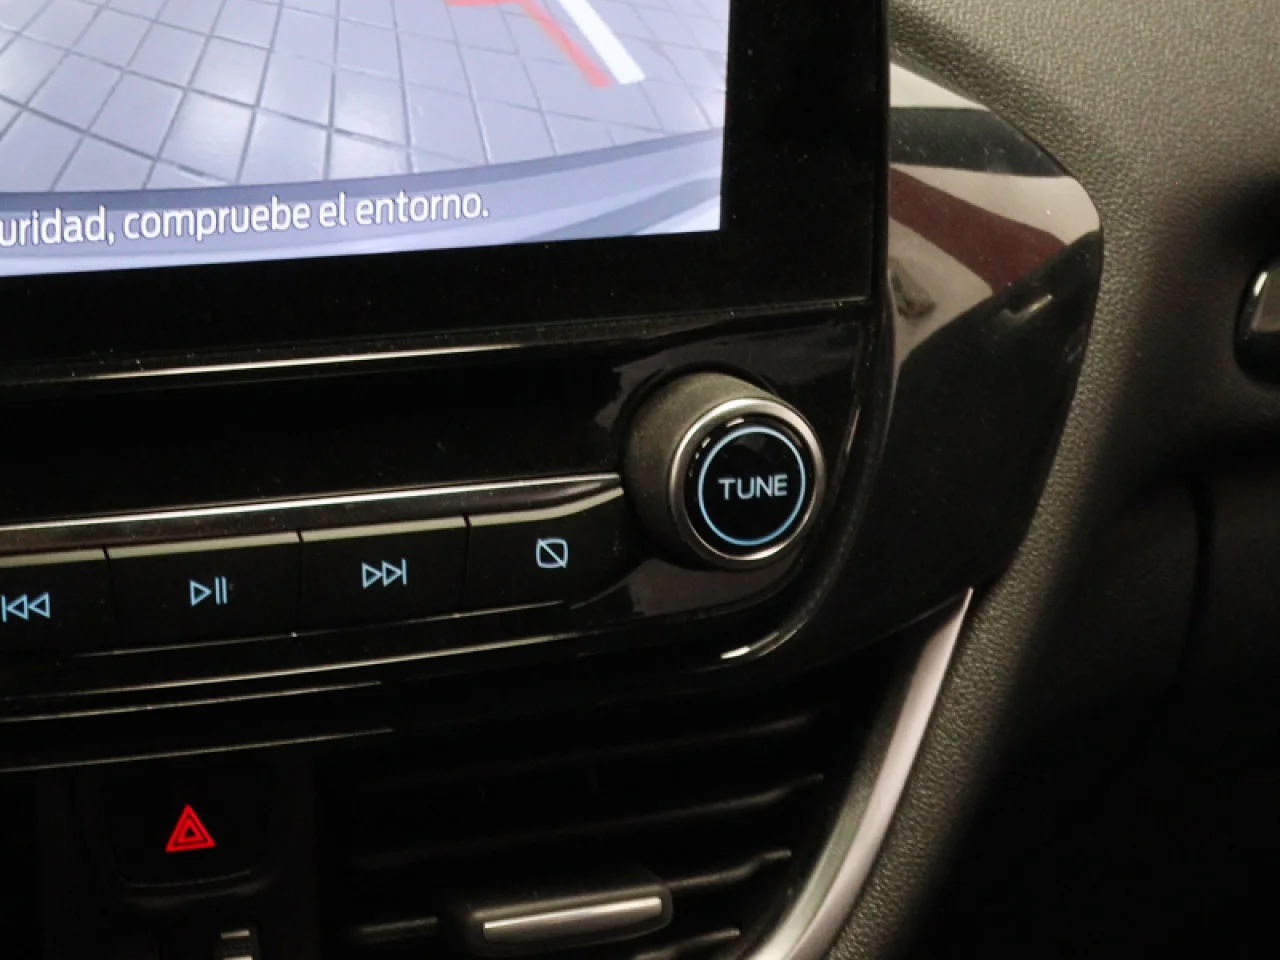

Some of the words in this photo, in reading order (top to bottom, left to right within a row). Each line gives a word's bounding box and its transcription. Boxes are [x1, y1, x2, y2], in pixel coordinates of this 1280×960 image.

[124, 194, 312, 243] compruebe
[319, 191, 347, 228] el
[356, 189, 489, 226] entorno.
[718, 473, 787, 500] TUNE
